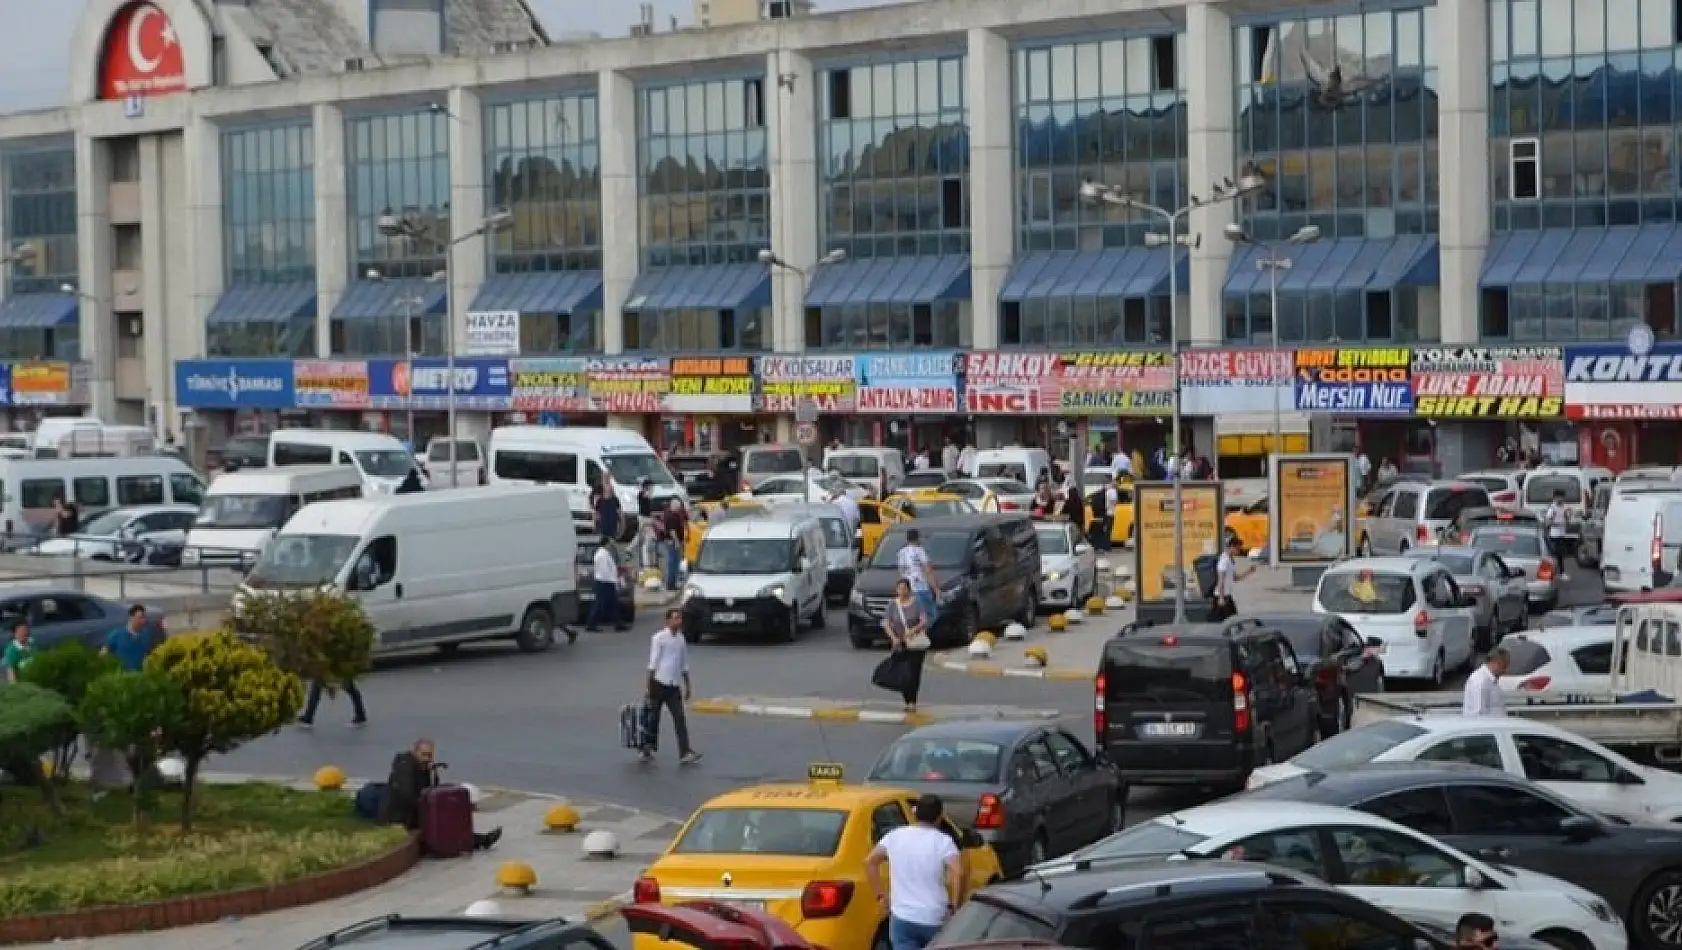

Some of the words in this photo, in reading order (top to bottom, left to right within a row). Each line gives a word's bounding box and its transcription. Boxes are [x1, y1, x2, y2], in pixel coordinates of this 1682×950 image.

[1414, 347, 1488, 361] TOKAT
[412, 367, 478, 390] METRO
[1472, 375, 1543, 396] ADANA
[1299, 383, 1366, 408] Mersin
[1370, 383, 1407, 408] Nur
[1496, 396, 1562, 416] HAS
